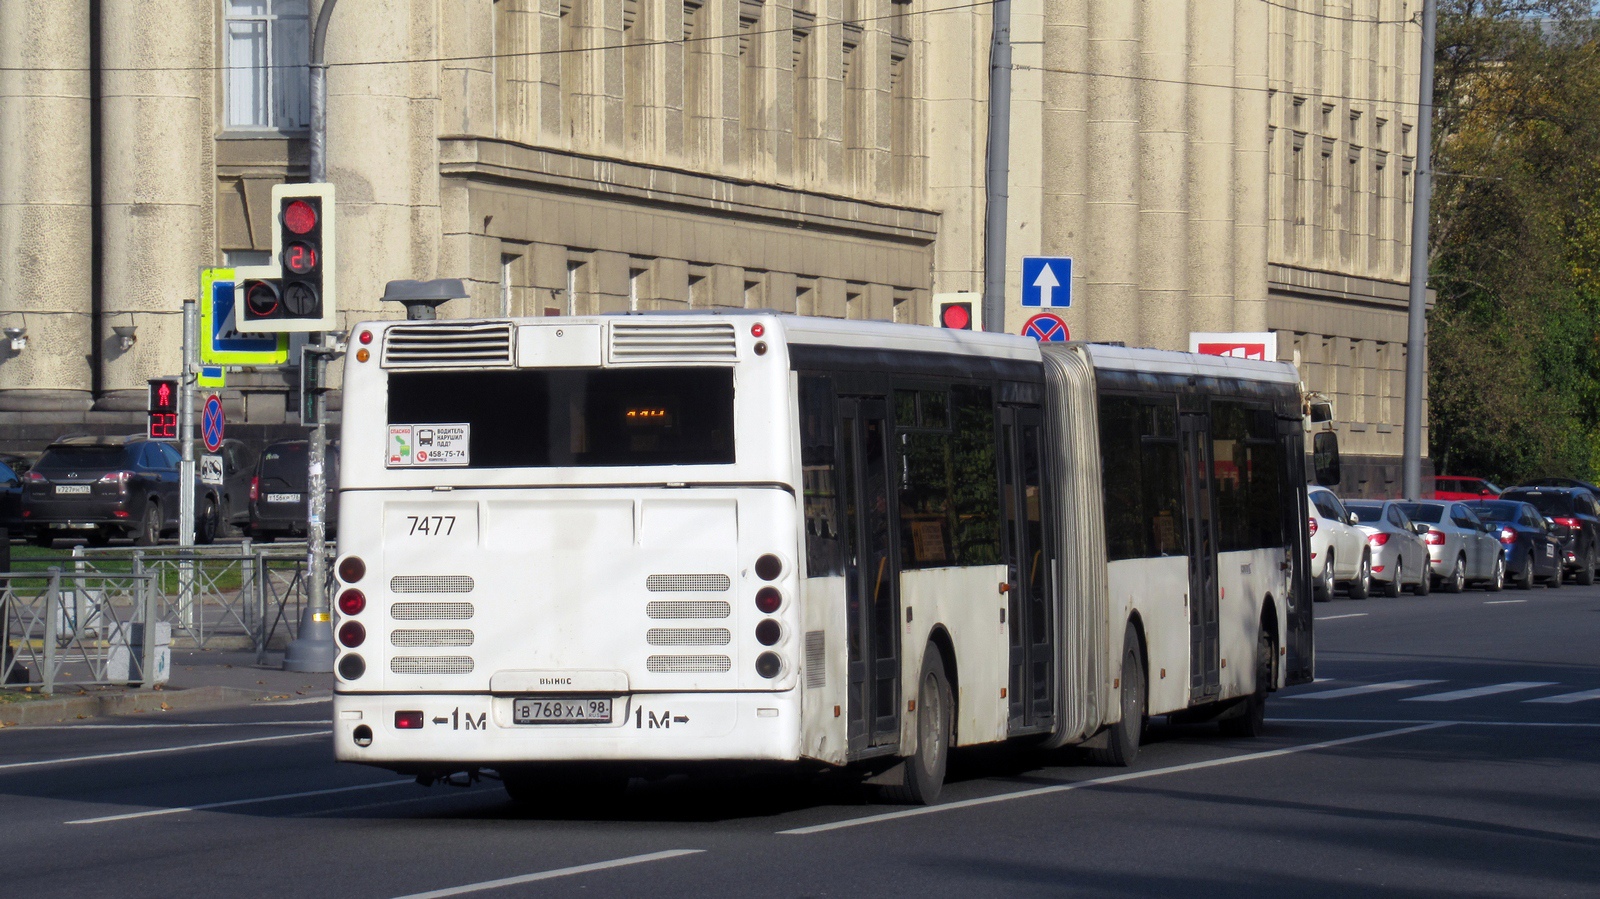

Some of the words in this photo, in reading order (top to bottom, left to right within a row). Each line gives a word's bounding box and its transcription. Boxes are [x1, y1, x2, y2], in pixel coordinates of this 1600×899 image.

[291, 246, 316, 268] 21
[151, 413, 176, 436] 22
[407, 516, 456, 535] 7477
